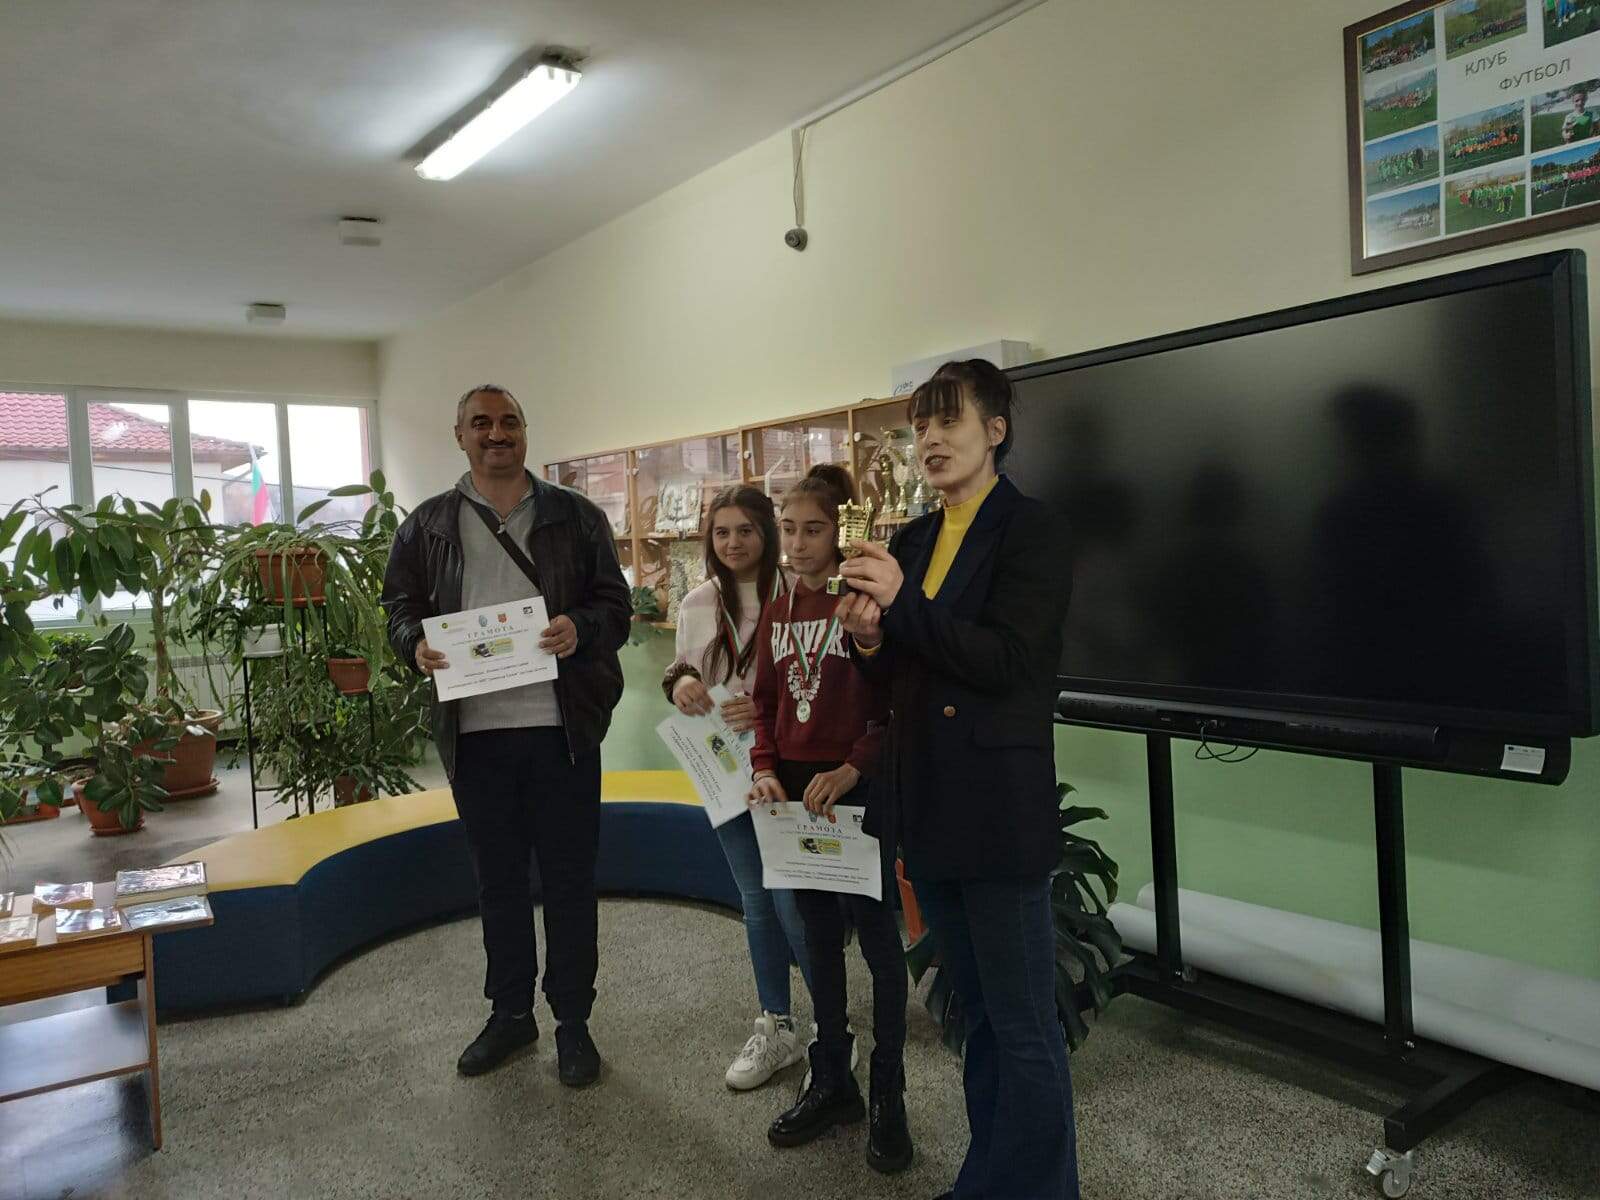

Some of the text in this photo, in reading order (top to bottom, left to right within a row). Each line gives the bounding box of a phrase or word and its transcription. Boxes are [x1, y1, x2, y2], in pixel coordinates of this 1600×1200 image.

[1464, 50, 1508, 77] КЛУБ
[1499, 57, 1571, 91] ФУТБОЛ
[467, 625, 514, 639] ГРАМОТА
[797, 823, 843, 834] ГРАМОТА
